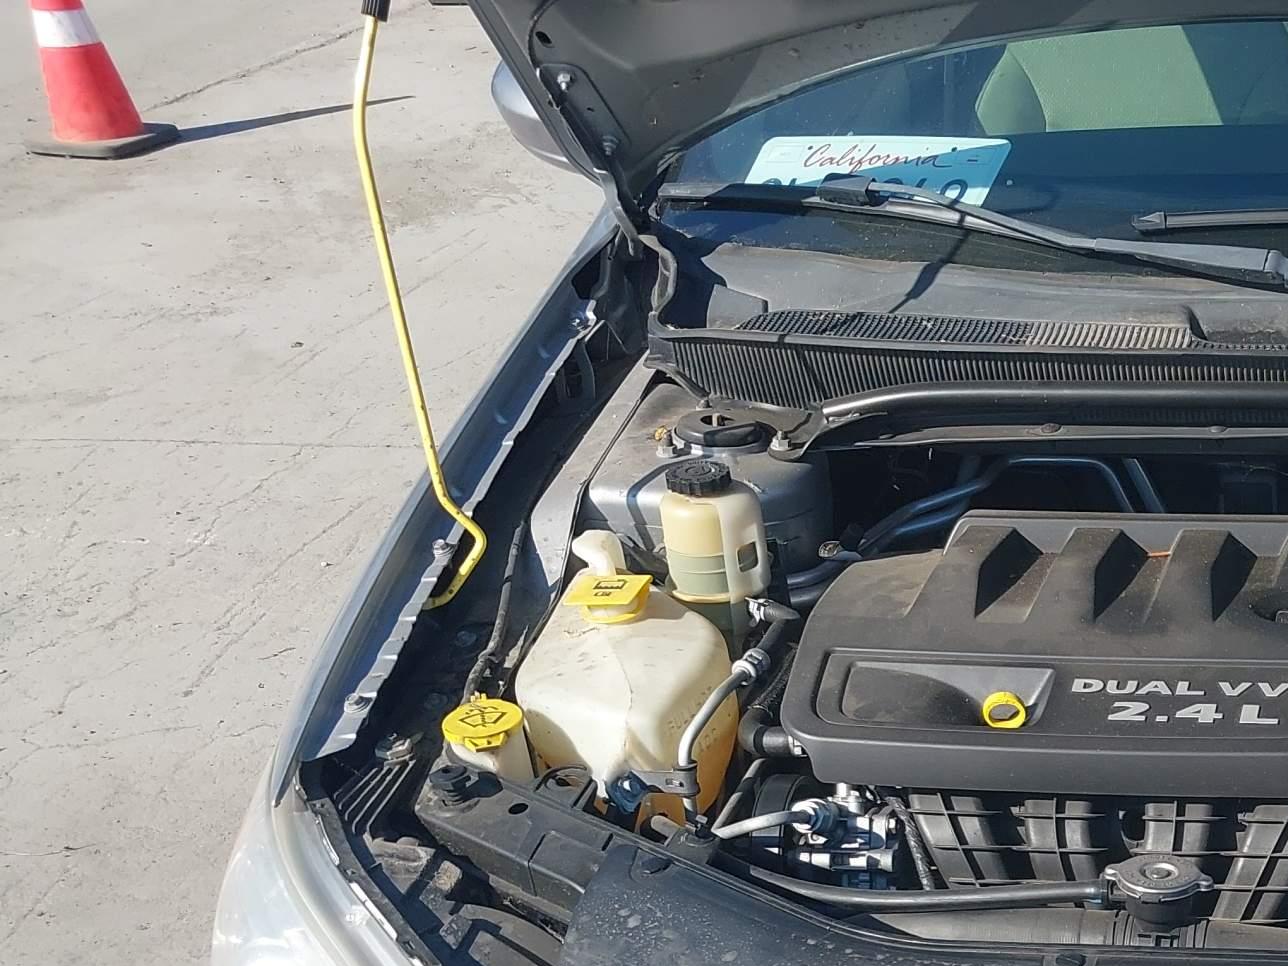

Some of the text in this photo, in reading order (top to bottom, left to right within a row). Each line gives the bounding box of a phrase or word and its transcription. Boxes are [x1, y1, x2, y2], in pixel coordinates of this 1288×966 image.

[803, 144, 951, 176] California
[1071, 678, 1206, 697] DUAL
[1107, 701, 1279, 725] 2.4 L
